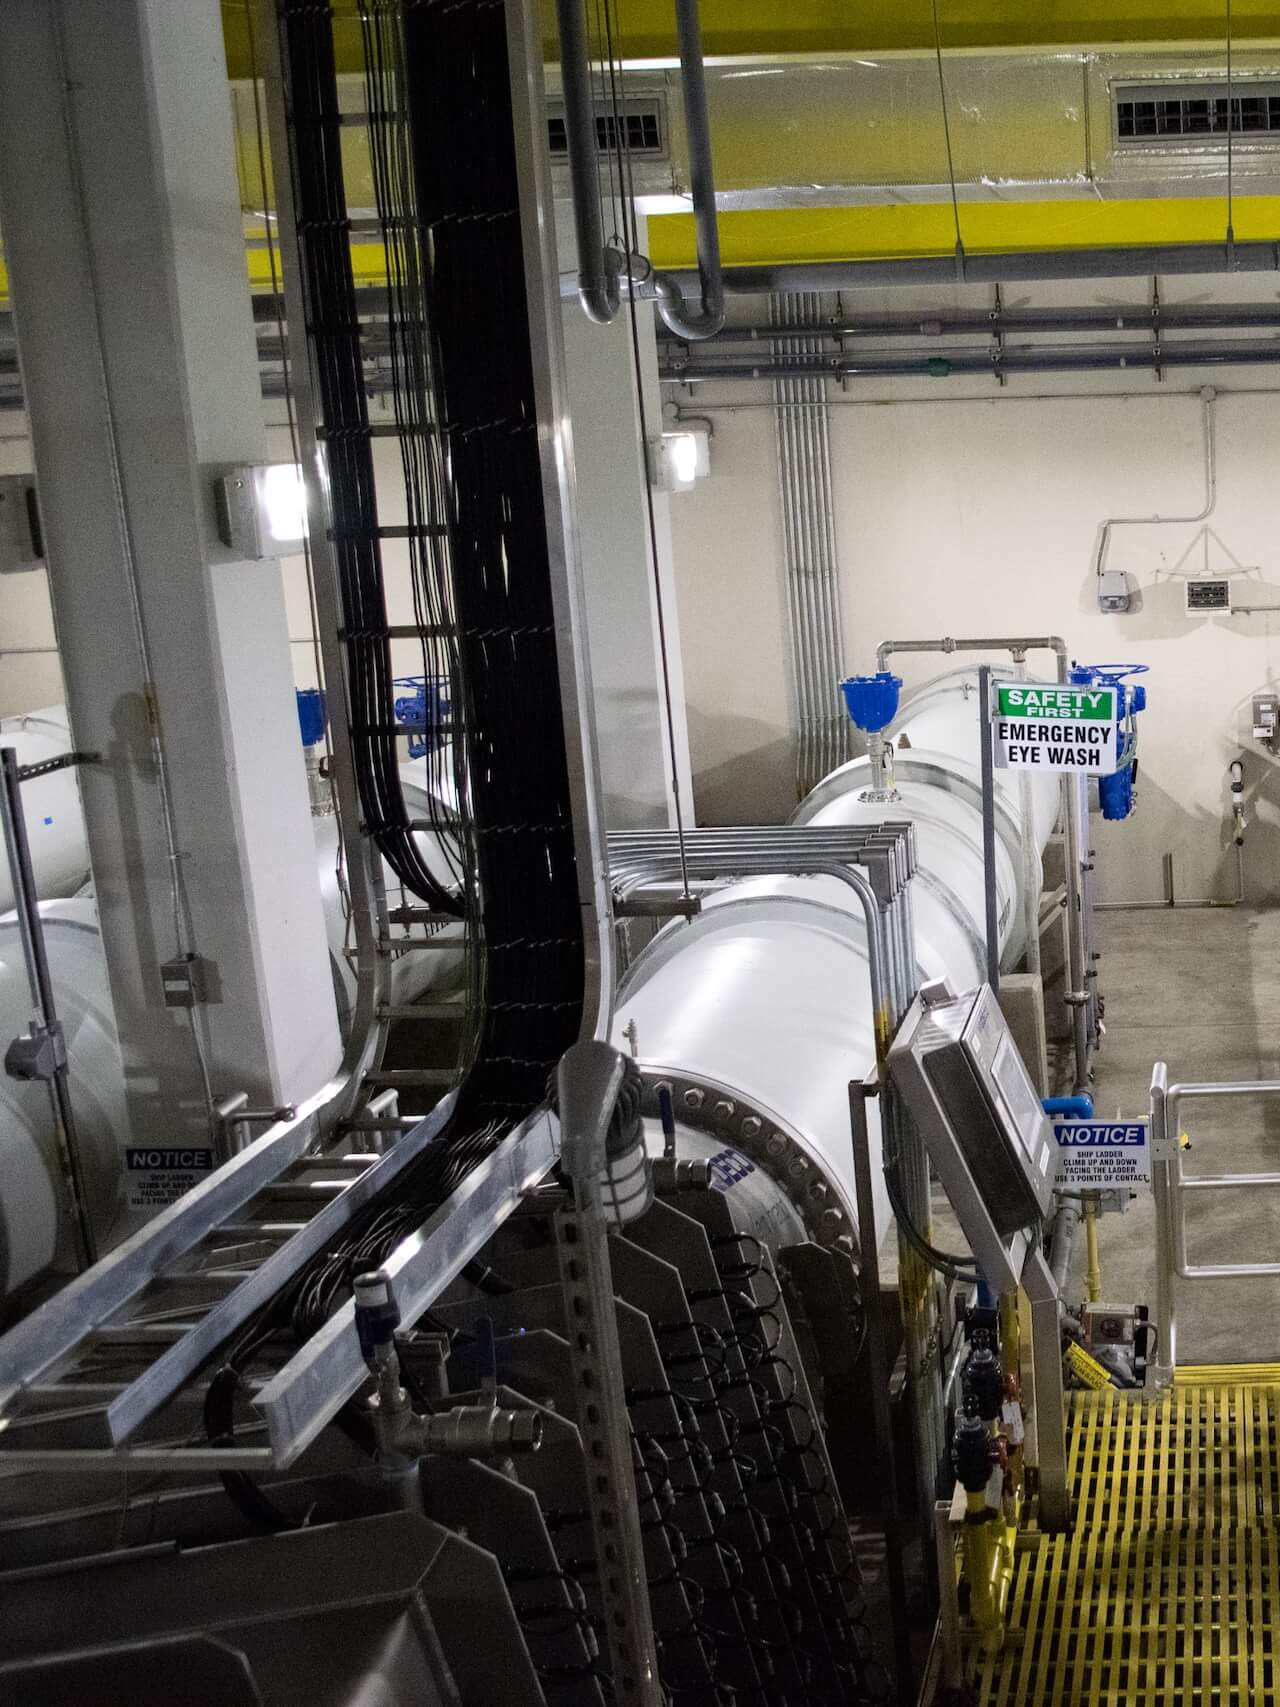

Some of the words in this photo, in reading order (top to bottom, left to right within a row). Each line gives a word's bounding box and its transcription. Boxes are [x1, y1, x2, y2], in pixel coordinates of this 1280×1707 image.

[1008, 690, 1103, 708] SAFETY
[1026, 707, 1085, 718] FIRST
[999, 722, 1111, 745] EMERGENCY
[1008, 746, 1041, 764] EYE
[1047, 747, 1100, 766] WASH
[1059, 1127, 1139, 1143] NOTICE
[132, 1151, 206, 1167] NOTICE
[1108, 1166, 1136, 1174] LADDER
[1115, 1174, 1147, 1182] CONTACT
